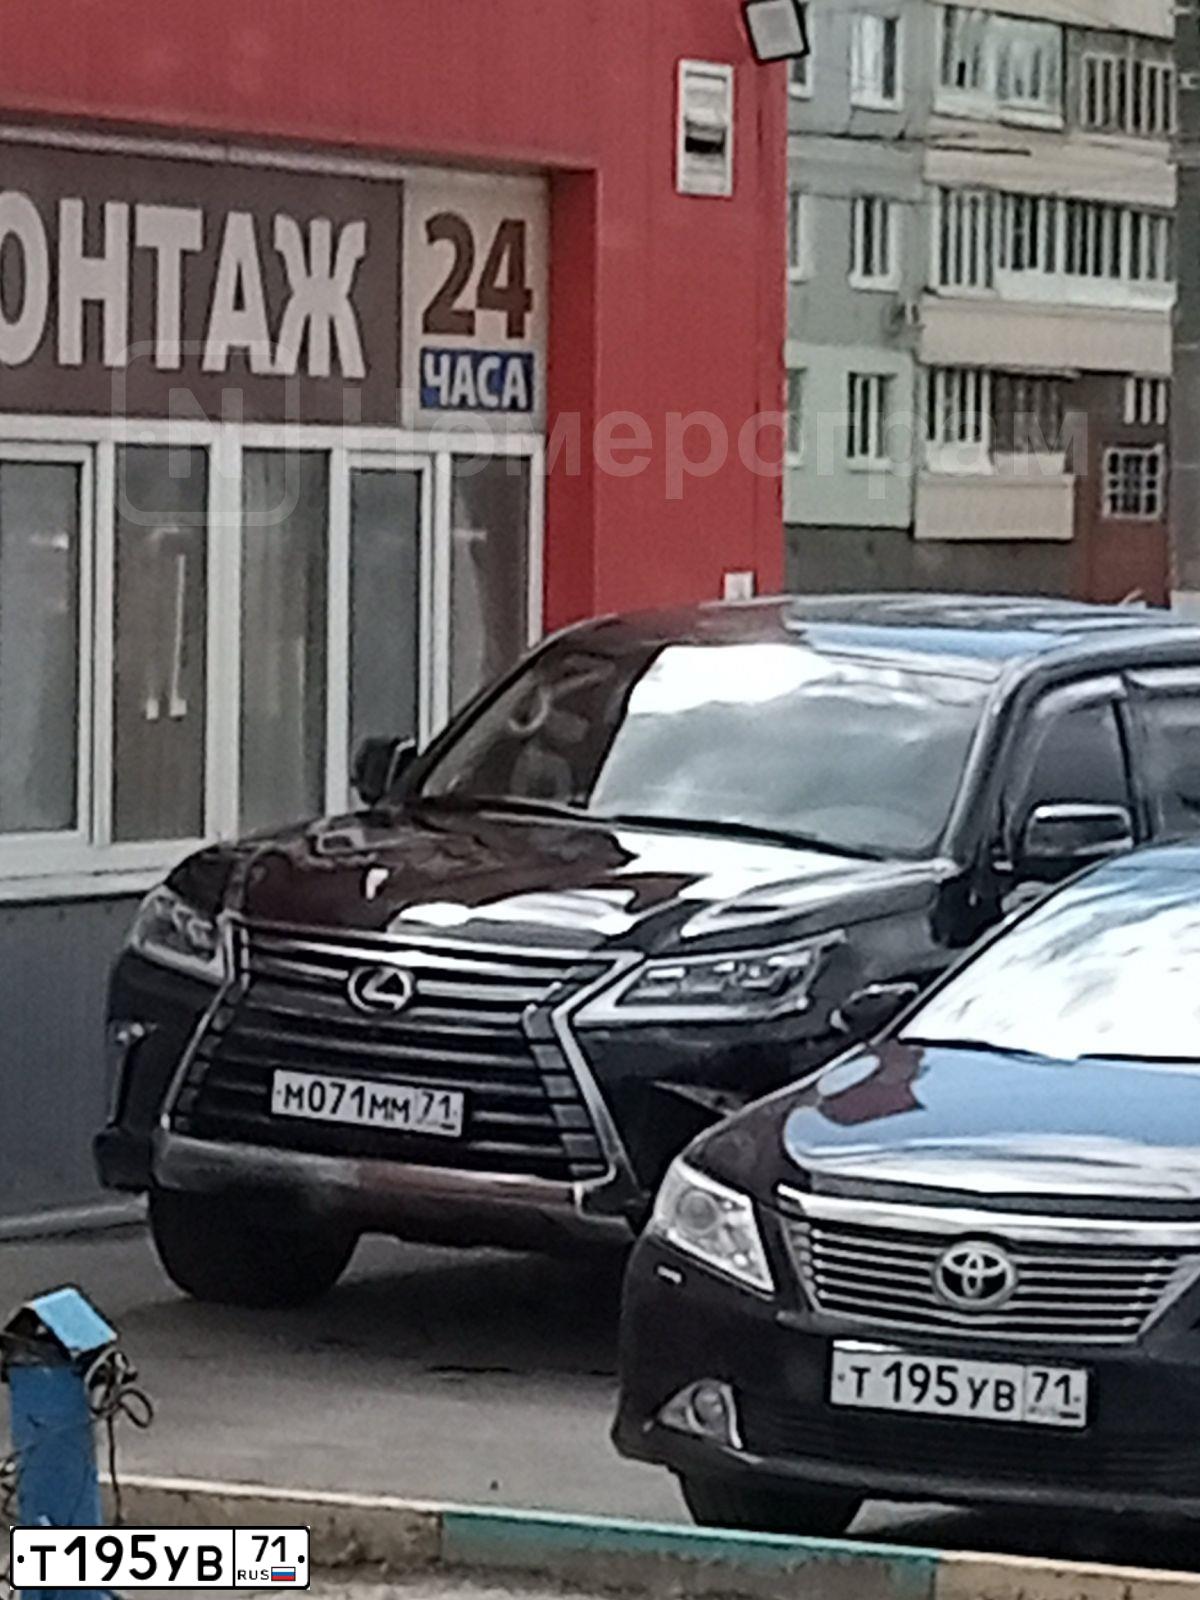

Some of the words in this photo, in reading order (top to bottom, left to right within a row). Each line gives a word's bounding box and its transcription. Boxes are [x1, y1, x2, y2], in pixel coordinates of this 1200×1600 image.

[0, 190, 367, 379] ОНТАЖ
[421, 212, 534, 339] 24
[422, 353, 529, 410] ЧАСА
